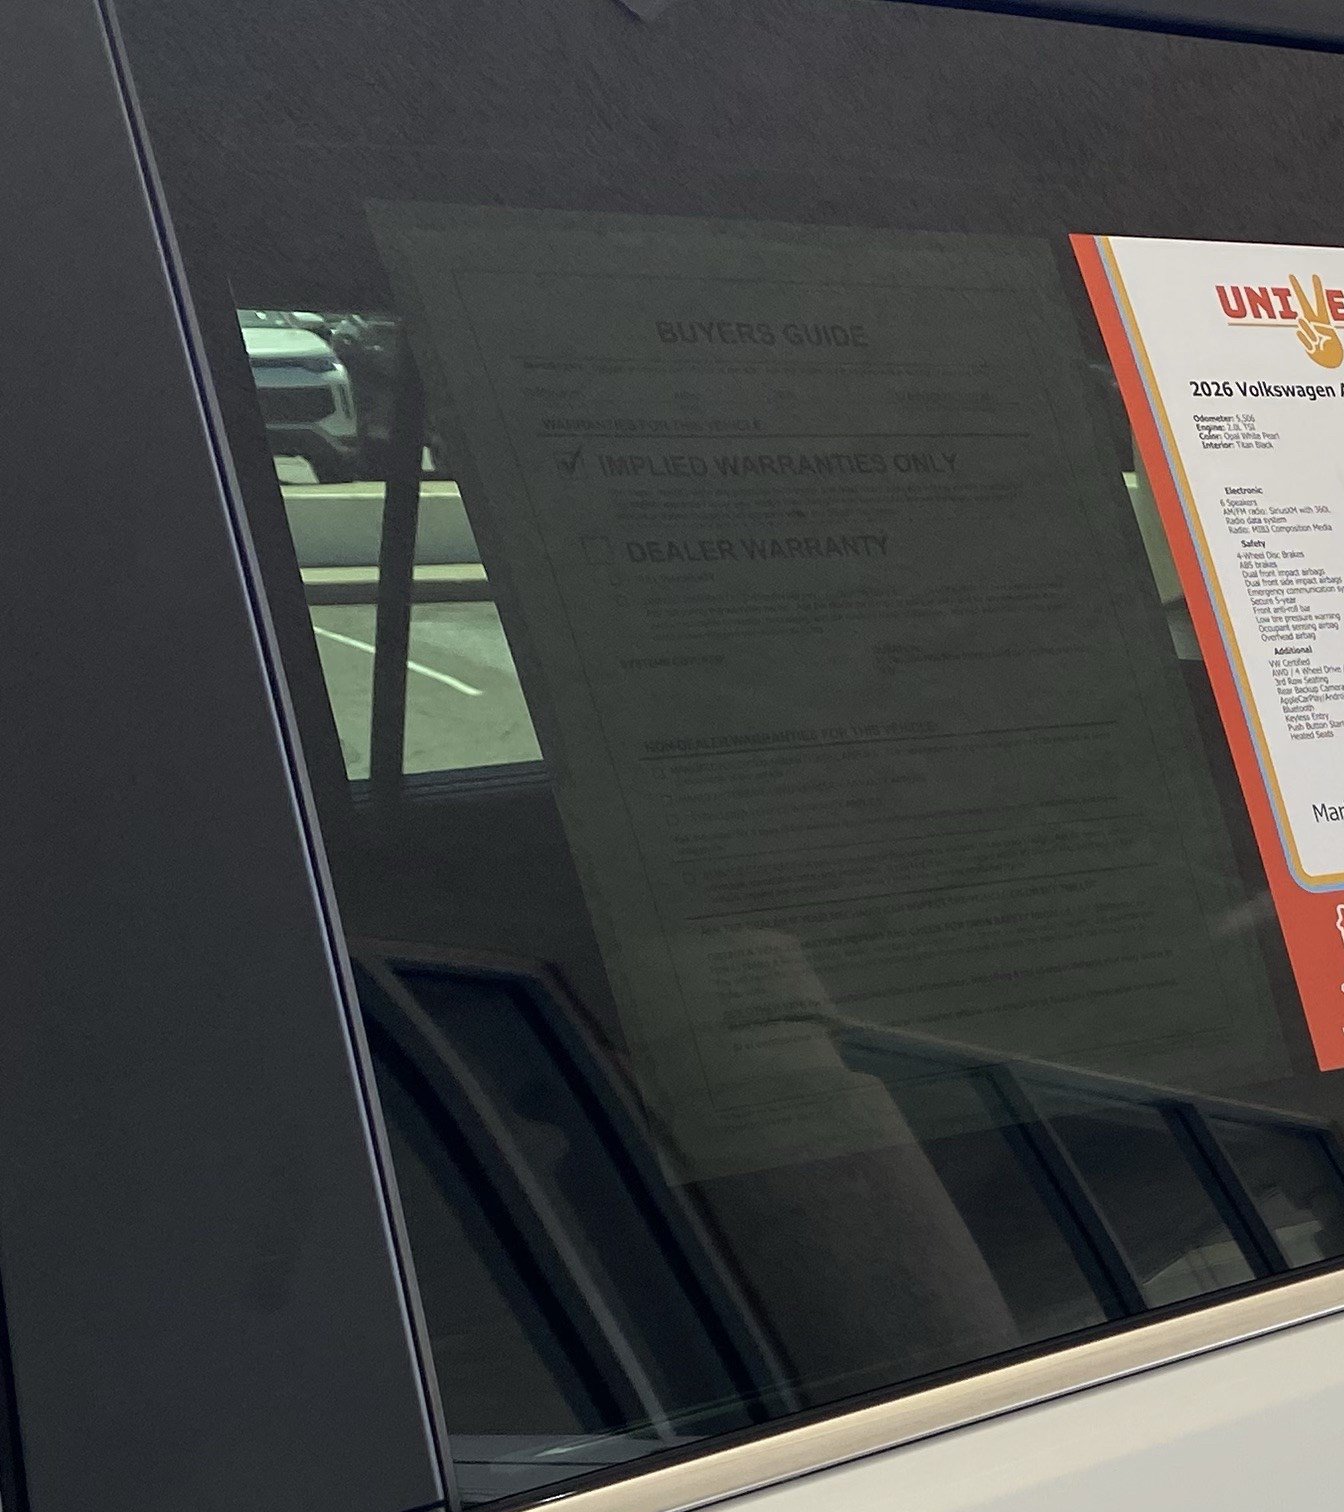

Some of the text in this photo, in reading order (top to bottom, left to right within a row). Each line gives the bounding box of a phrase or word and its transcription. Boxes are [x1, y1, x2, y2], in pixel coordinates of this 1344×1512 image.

[656, 320, 869, 349] BUYERS GUIDE
[1190, 381, 1233, 398] 2026
[1236, 381, 1335, 401] Volkswagen
[1196, 424, 1225, 434] Engine:
[1199, 432, 1222, 440] Color:
[1224, 432, 1240, 441] Opal
[1242, 432, 1261, 440] White
[1202, 441, 1234, 449] Interior:
[600, 451, 958, 478] IMPLIED WARRANTIES ONLY
[1226, 499, 1257, 507] Speakers
[626, 533, 889, 564] DEALER WARRANTY
[1241, 540, 1265, 548] Safety
[1282, 551, 1305, 559] Brakes
[1242, 570, 1258, 578] Dual
[1245, 579, 1260, 587] Dual
[1253, 606, 1271, 614] Front
[1259, 624, 1290, 633] Occupant
[1261, 633, 1294, 642] Overhead
[1275, 645, 1312, 655] Additional
[1269, 658, 1310, 668] VW Certified
[1273, 669, 1289, 677] AWD
[1302, 667, 1322, 675] Wheel
[1324, 665, 1342, 673] Drive
[1304, 676, 1329, 684] Seating
[1295, 686, 1319, 694] Backup
[1320, 684, 1344, 692] Camera
[1283, 705, 1314, 713] Bluetooth
[1285, 713, 1329, 722] Keyless Entry
[1287, 723, 1304, 731] Push
[1306, 722, 1328, 730] Button
[1290, 731, 1334, 740] Heated Seats
